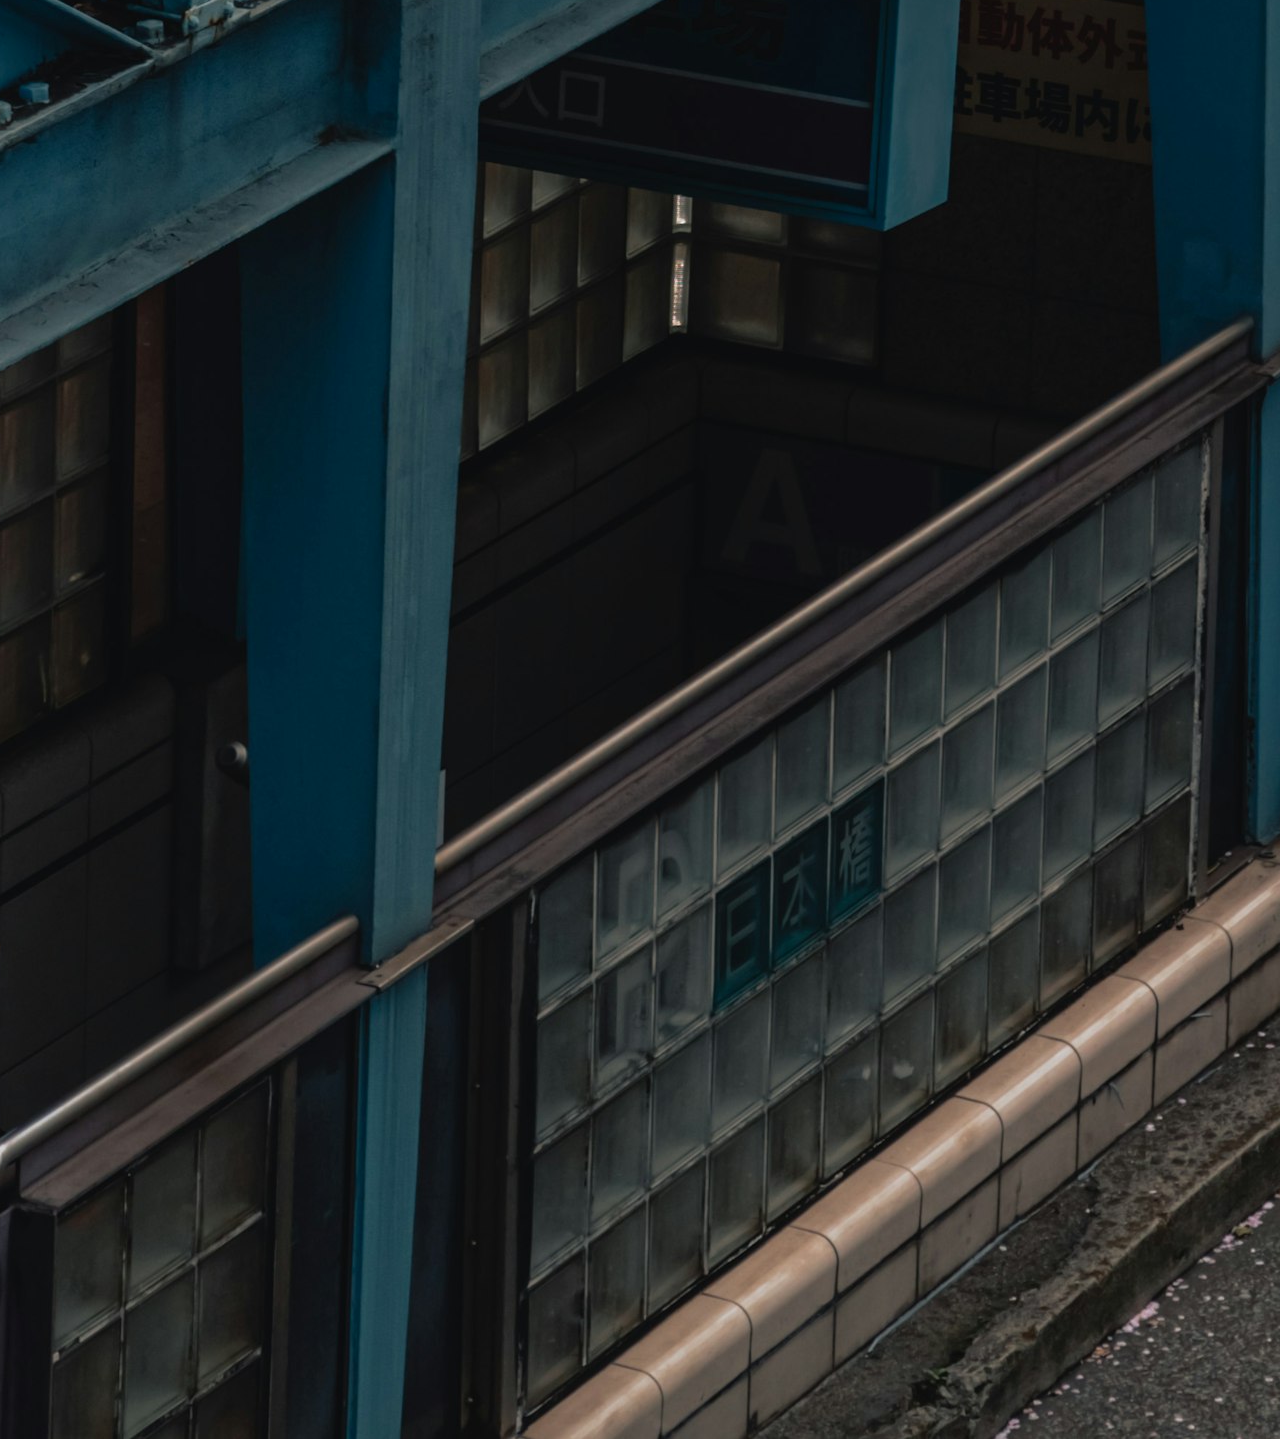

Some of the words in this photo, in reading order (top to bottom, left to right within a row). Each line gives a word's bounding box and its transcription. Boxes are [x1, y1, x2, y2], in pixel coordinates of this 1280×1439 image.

[721, 447, 823, 579] A
[725, 806, 877, 976] 日本橋
